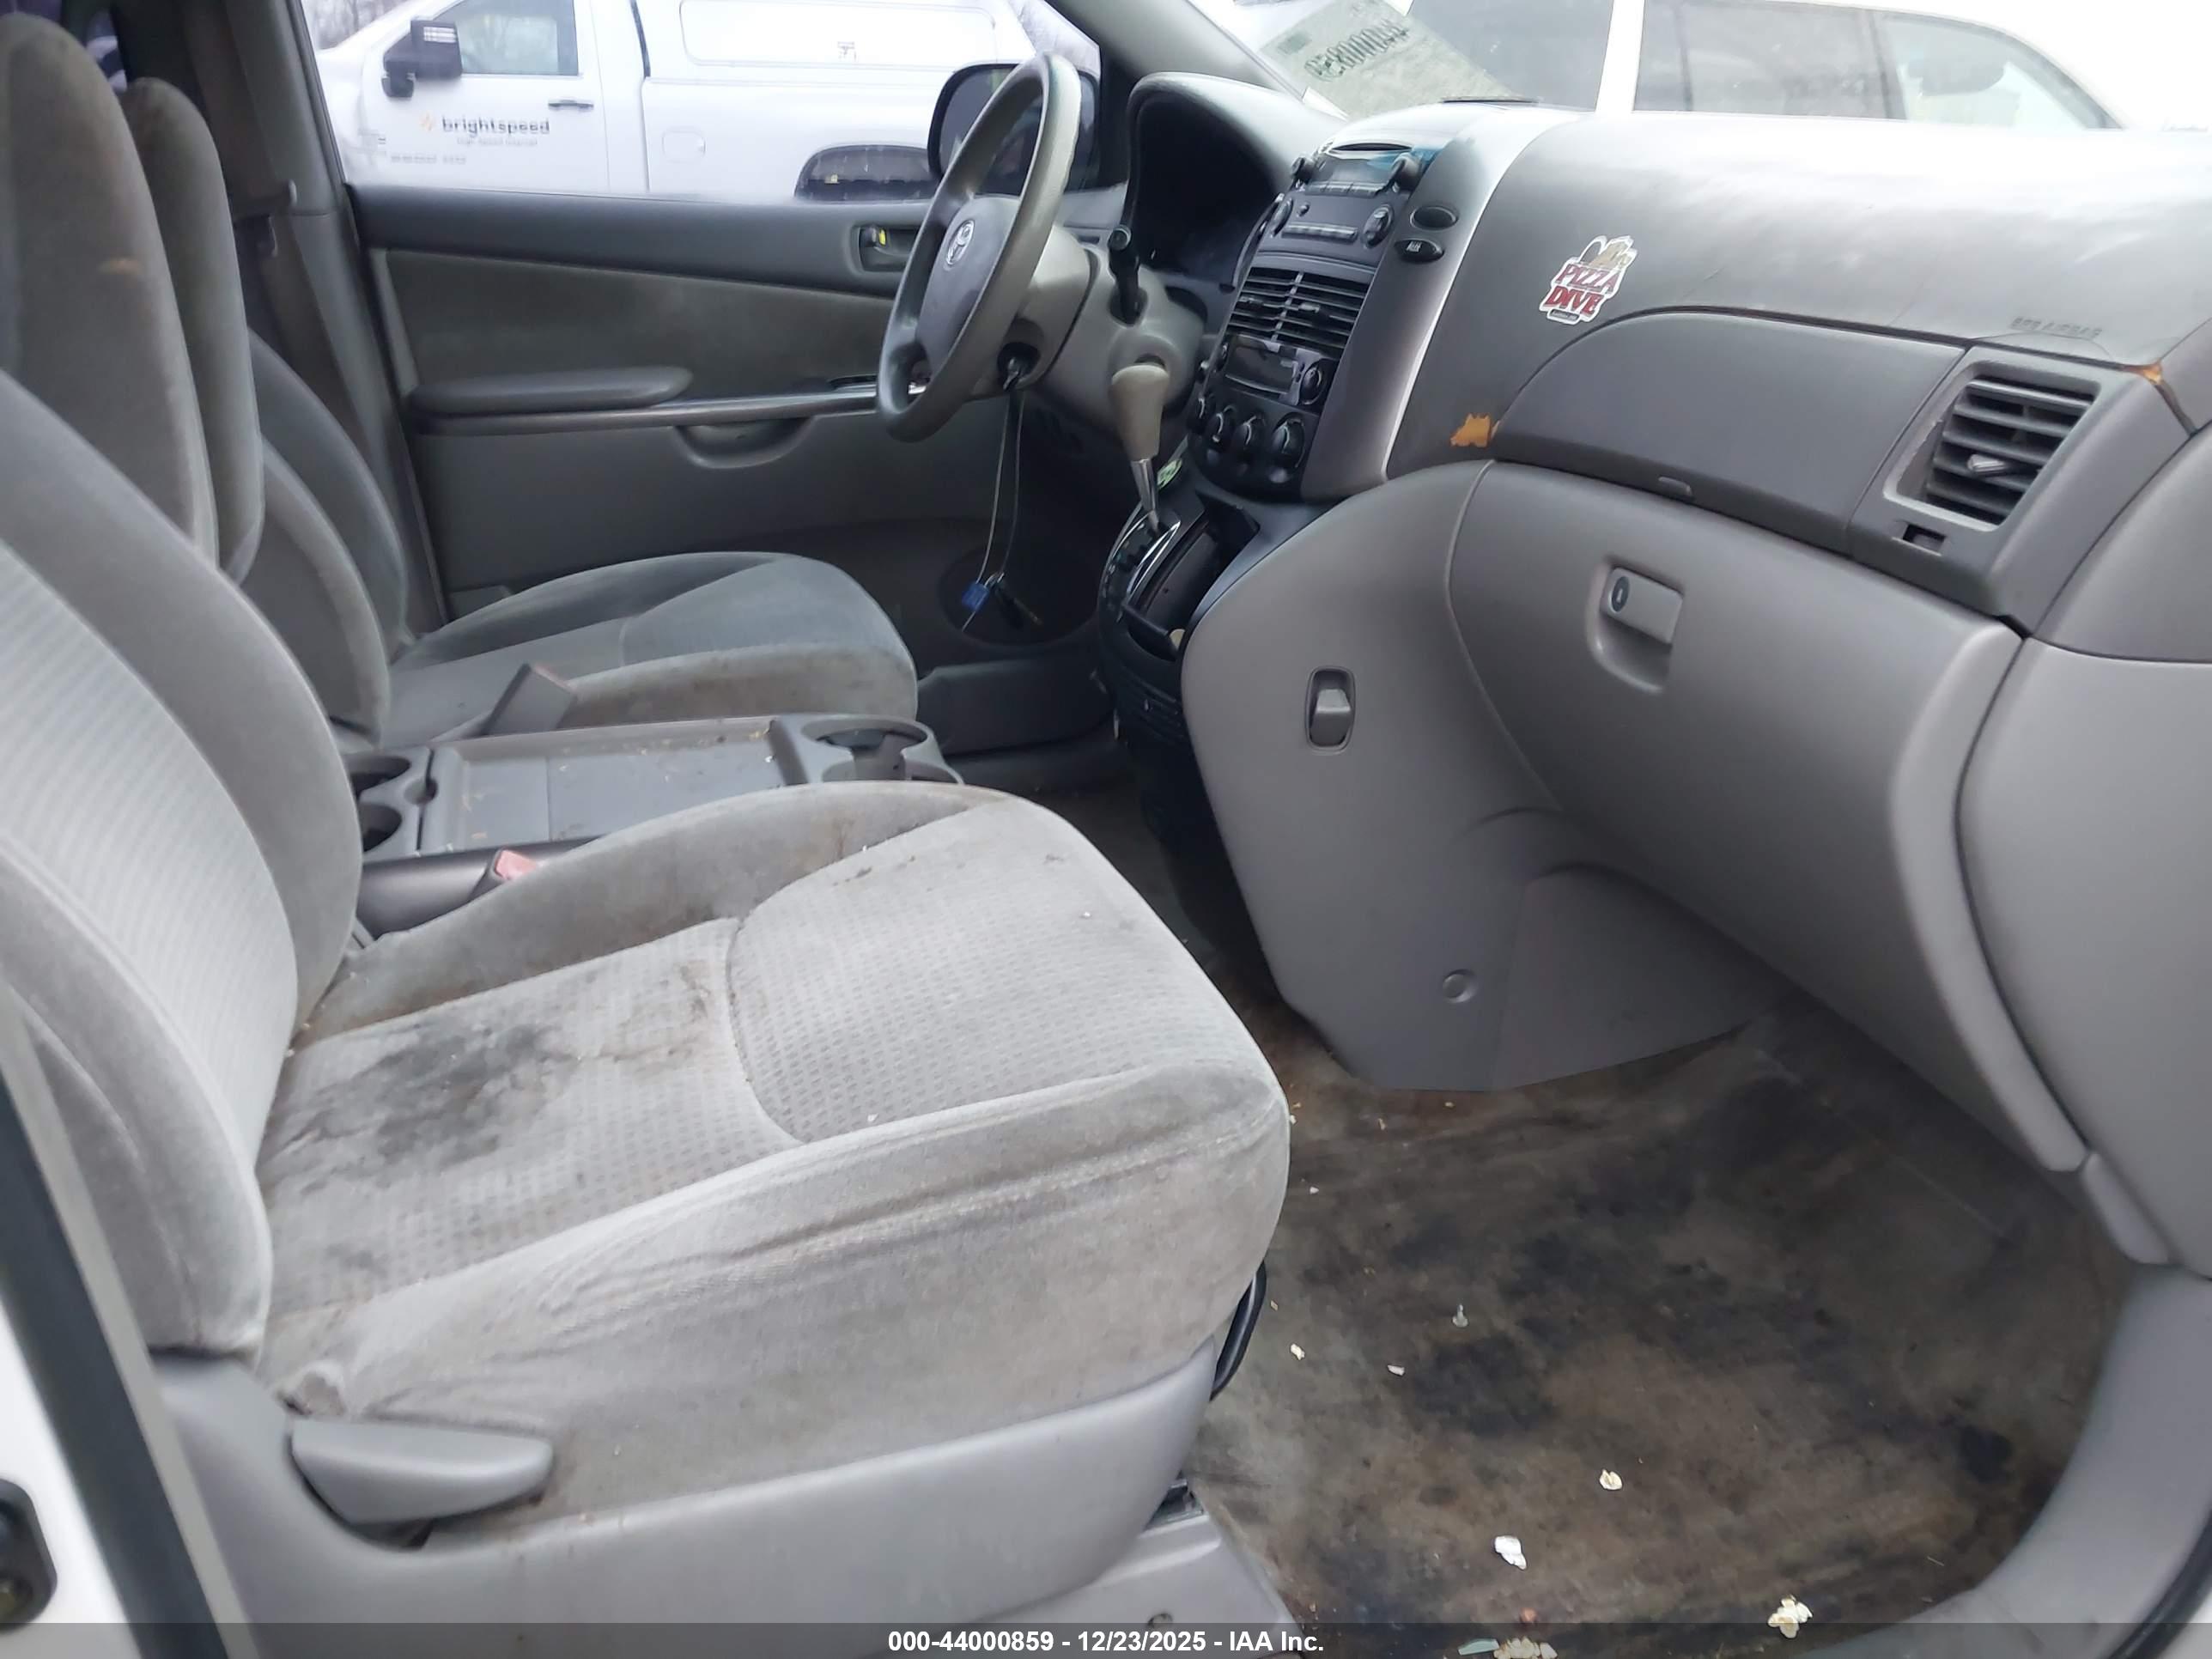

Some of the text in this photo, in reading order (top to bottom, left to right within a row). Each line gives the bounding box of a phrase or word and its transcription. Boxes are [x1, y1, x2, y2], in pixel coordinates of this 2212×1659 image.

[441, 115, 550, 137] brightspeed
[1555, 264, 1621, 295] PIZZA
[1543, 285, 1605, 316] DIVE
